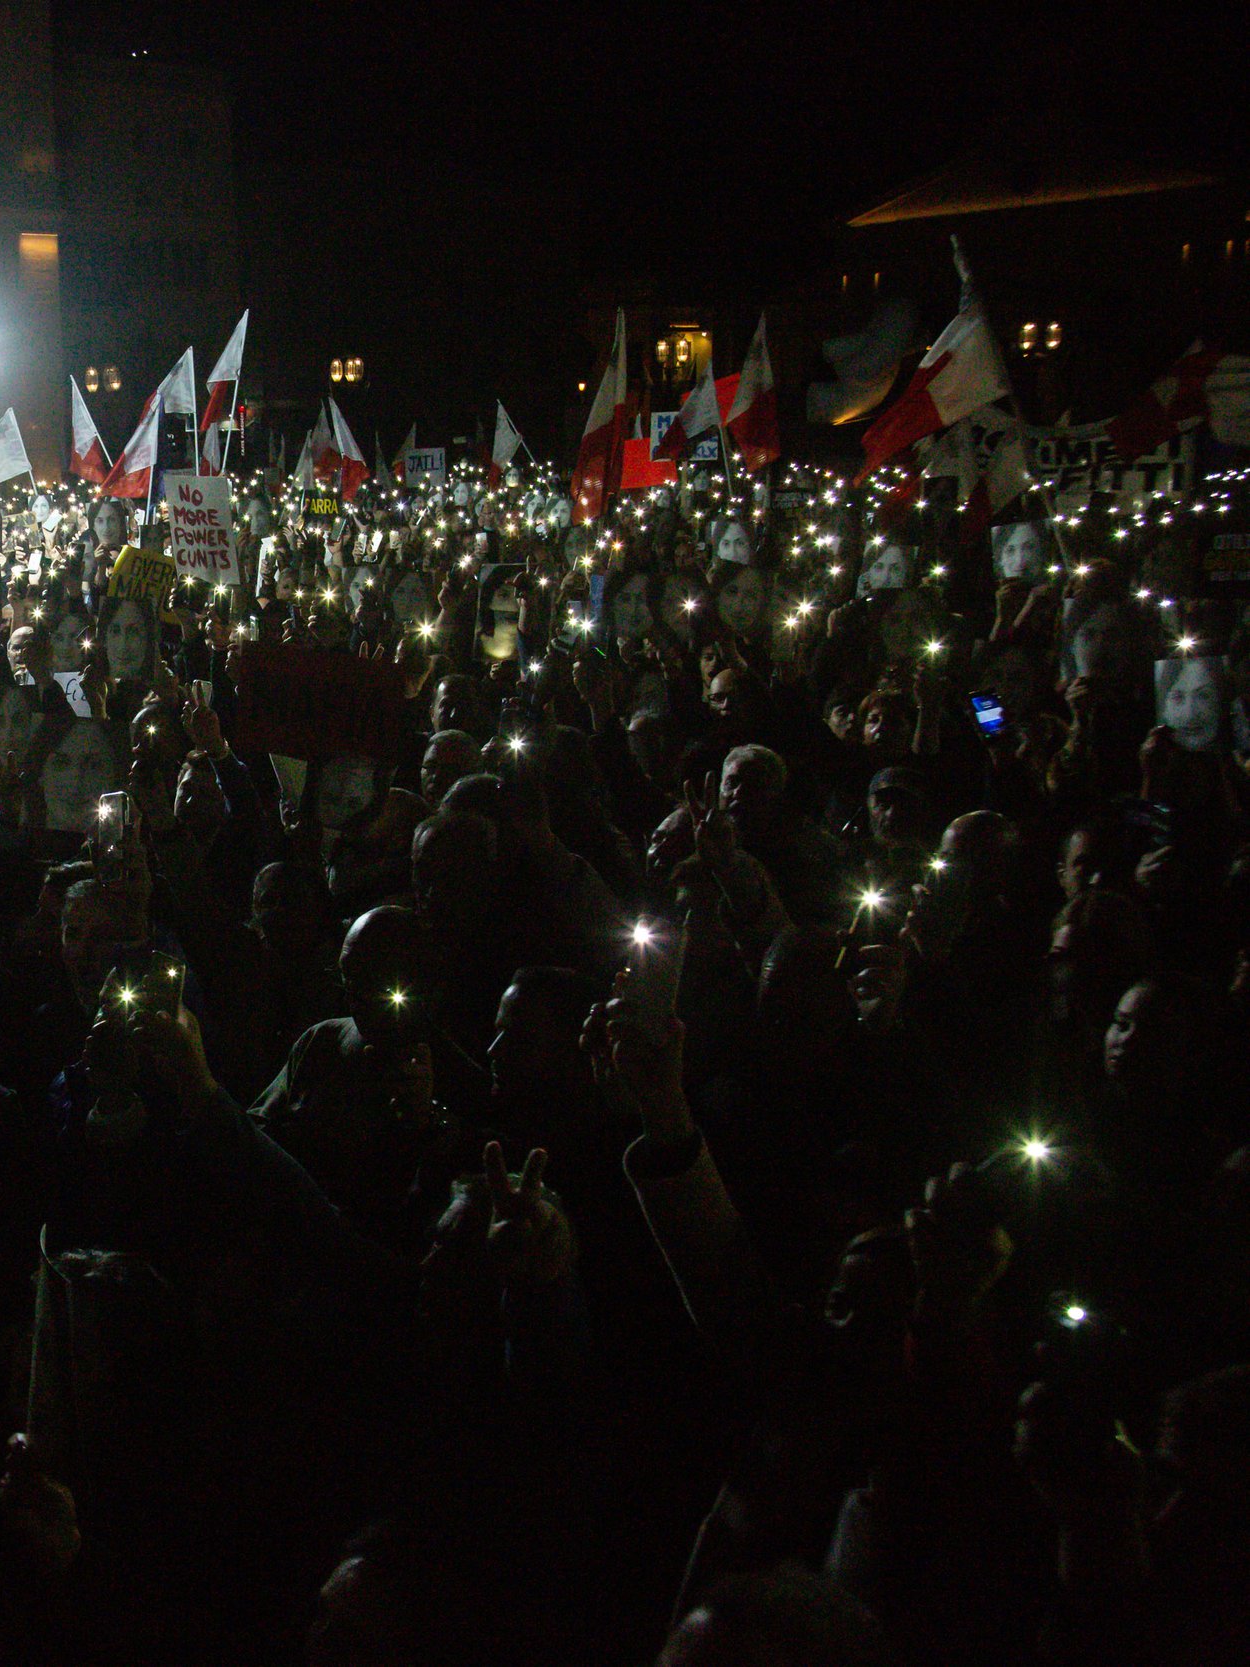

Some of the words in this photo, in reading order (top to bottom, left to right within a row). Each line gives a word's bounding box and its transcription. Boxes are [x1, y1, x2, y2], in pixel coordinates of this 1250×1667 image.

[178, 484, 203, 506] NO
[173, 506, 220, 526] MORE
[174, 527, 229, 548] POWER
[177, 549, 231, 570] CUNTS
